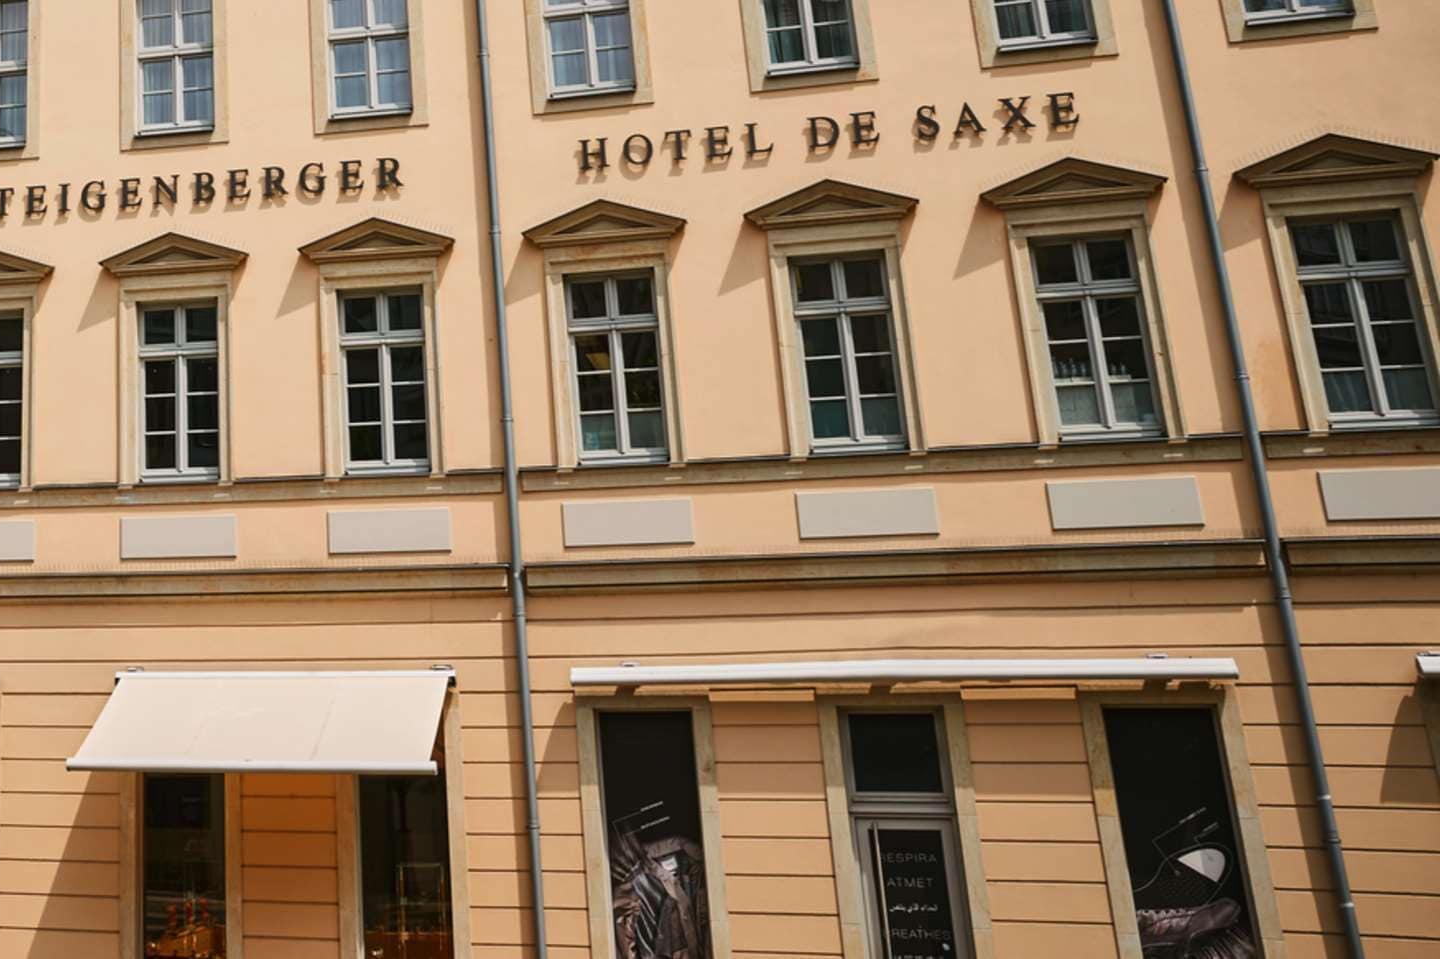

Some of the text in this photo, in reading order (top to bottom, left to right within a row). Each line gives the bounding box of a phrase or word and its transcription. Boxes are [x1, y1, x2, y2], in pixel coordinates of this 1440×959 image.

[578, 122, 773, 171] HOTEL
[806, 110, 880, 153] DE
[916, 92, 1079, 141] SAXE
[890, 928, 951, 941] REATHES
